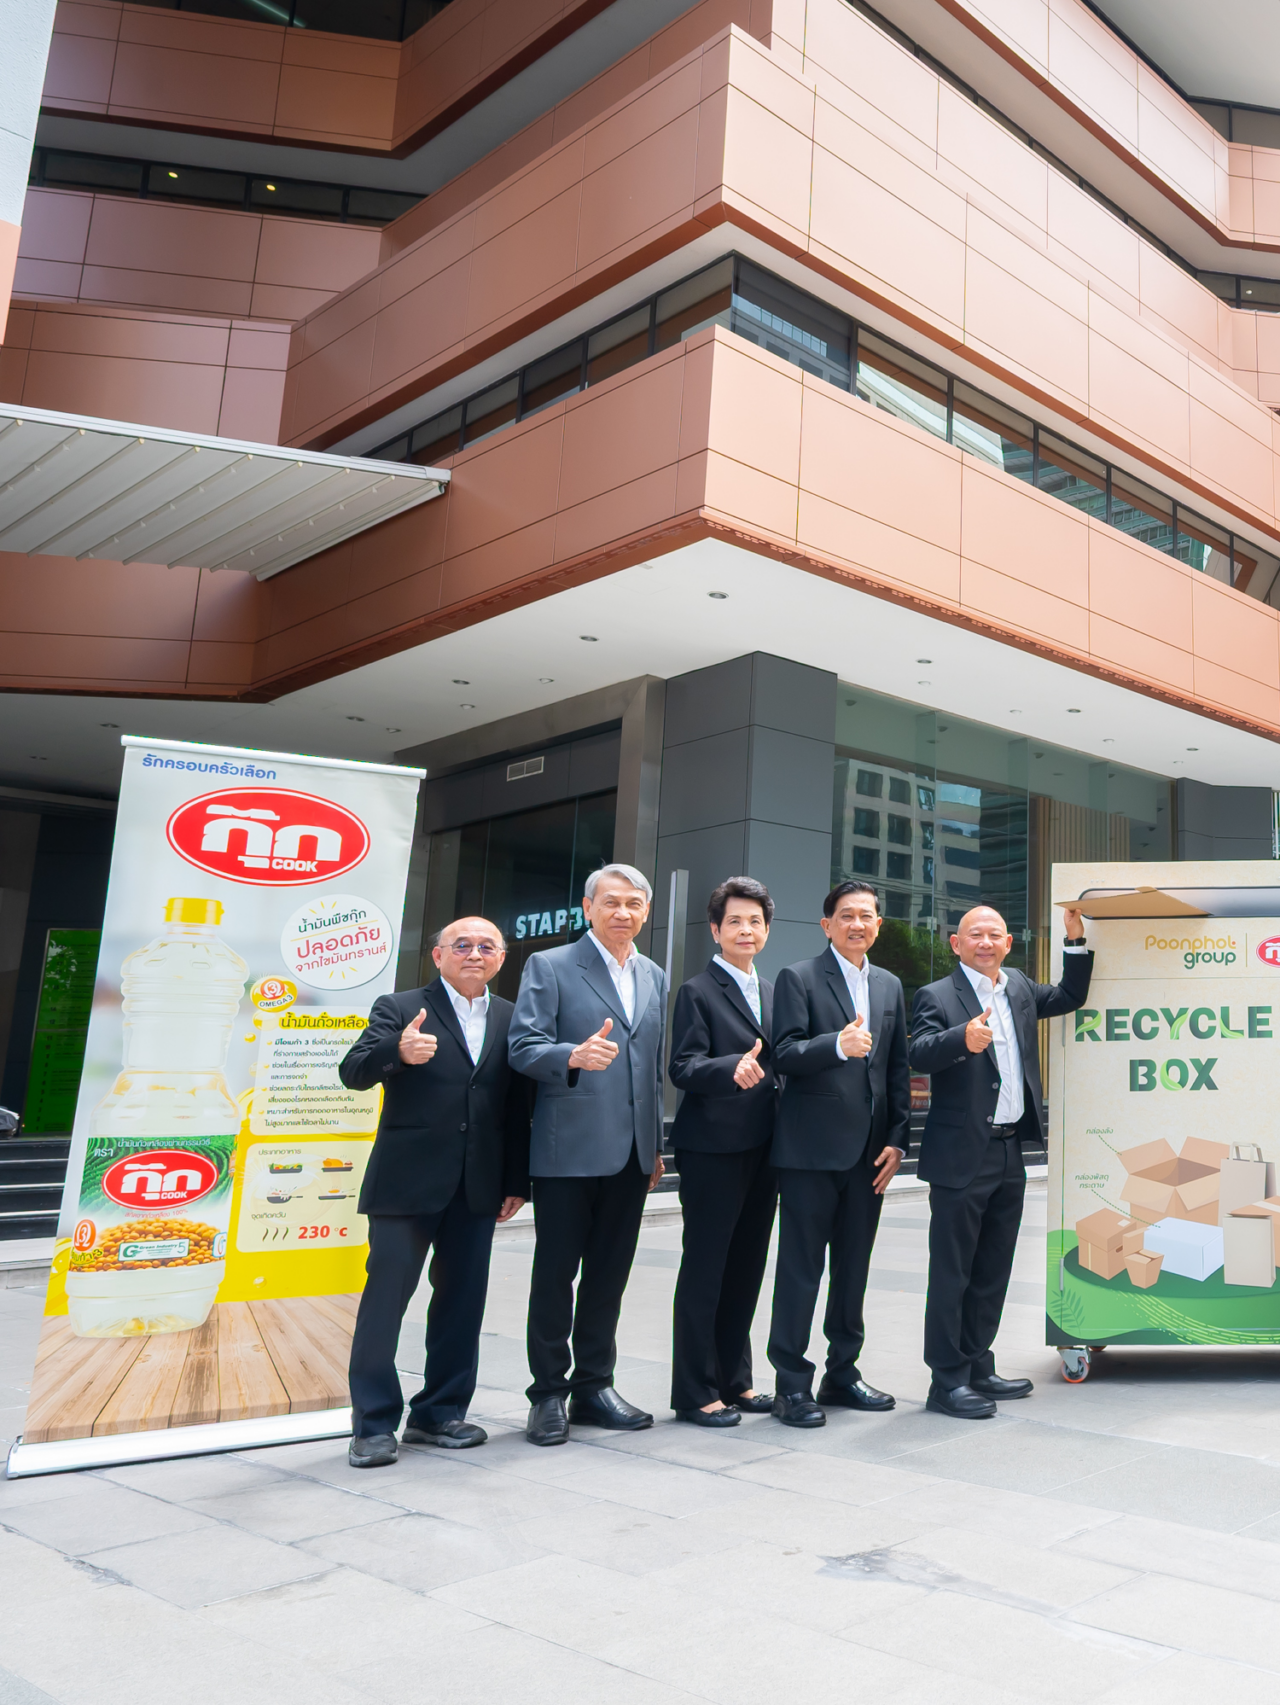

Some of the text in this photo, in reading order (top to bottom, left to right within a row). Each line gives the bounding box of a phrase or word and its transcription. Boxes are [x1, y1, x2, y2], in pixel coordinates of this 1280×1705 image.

[142, 753, 277, 780] รักครอบครัวเลือก
[272, 858, 318, 872] COOK
[298, 908, 367, 933] น้ำมันพืชกุ๊ก
[297, 926, 381, 959] ปลอดภัย
[295, 942, 387, 972] จากไขมันทรานส์
[1184, 951, 1236, 970] group
[259, 997, 287, 1008] OMEGA
[1075, 1006, 1273, 1042] RECYCLE
[1129, 1058, 1219, 1092] BOX
[94, 1148, 113, 1157] ตรา
[161, 1191, 188, 1200] COOK
[298, 1225, 330, 1239] 230
